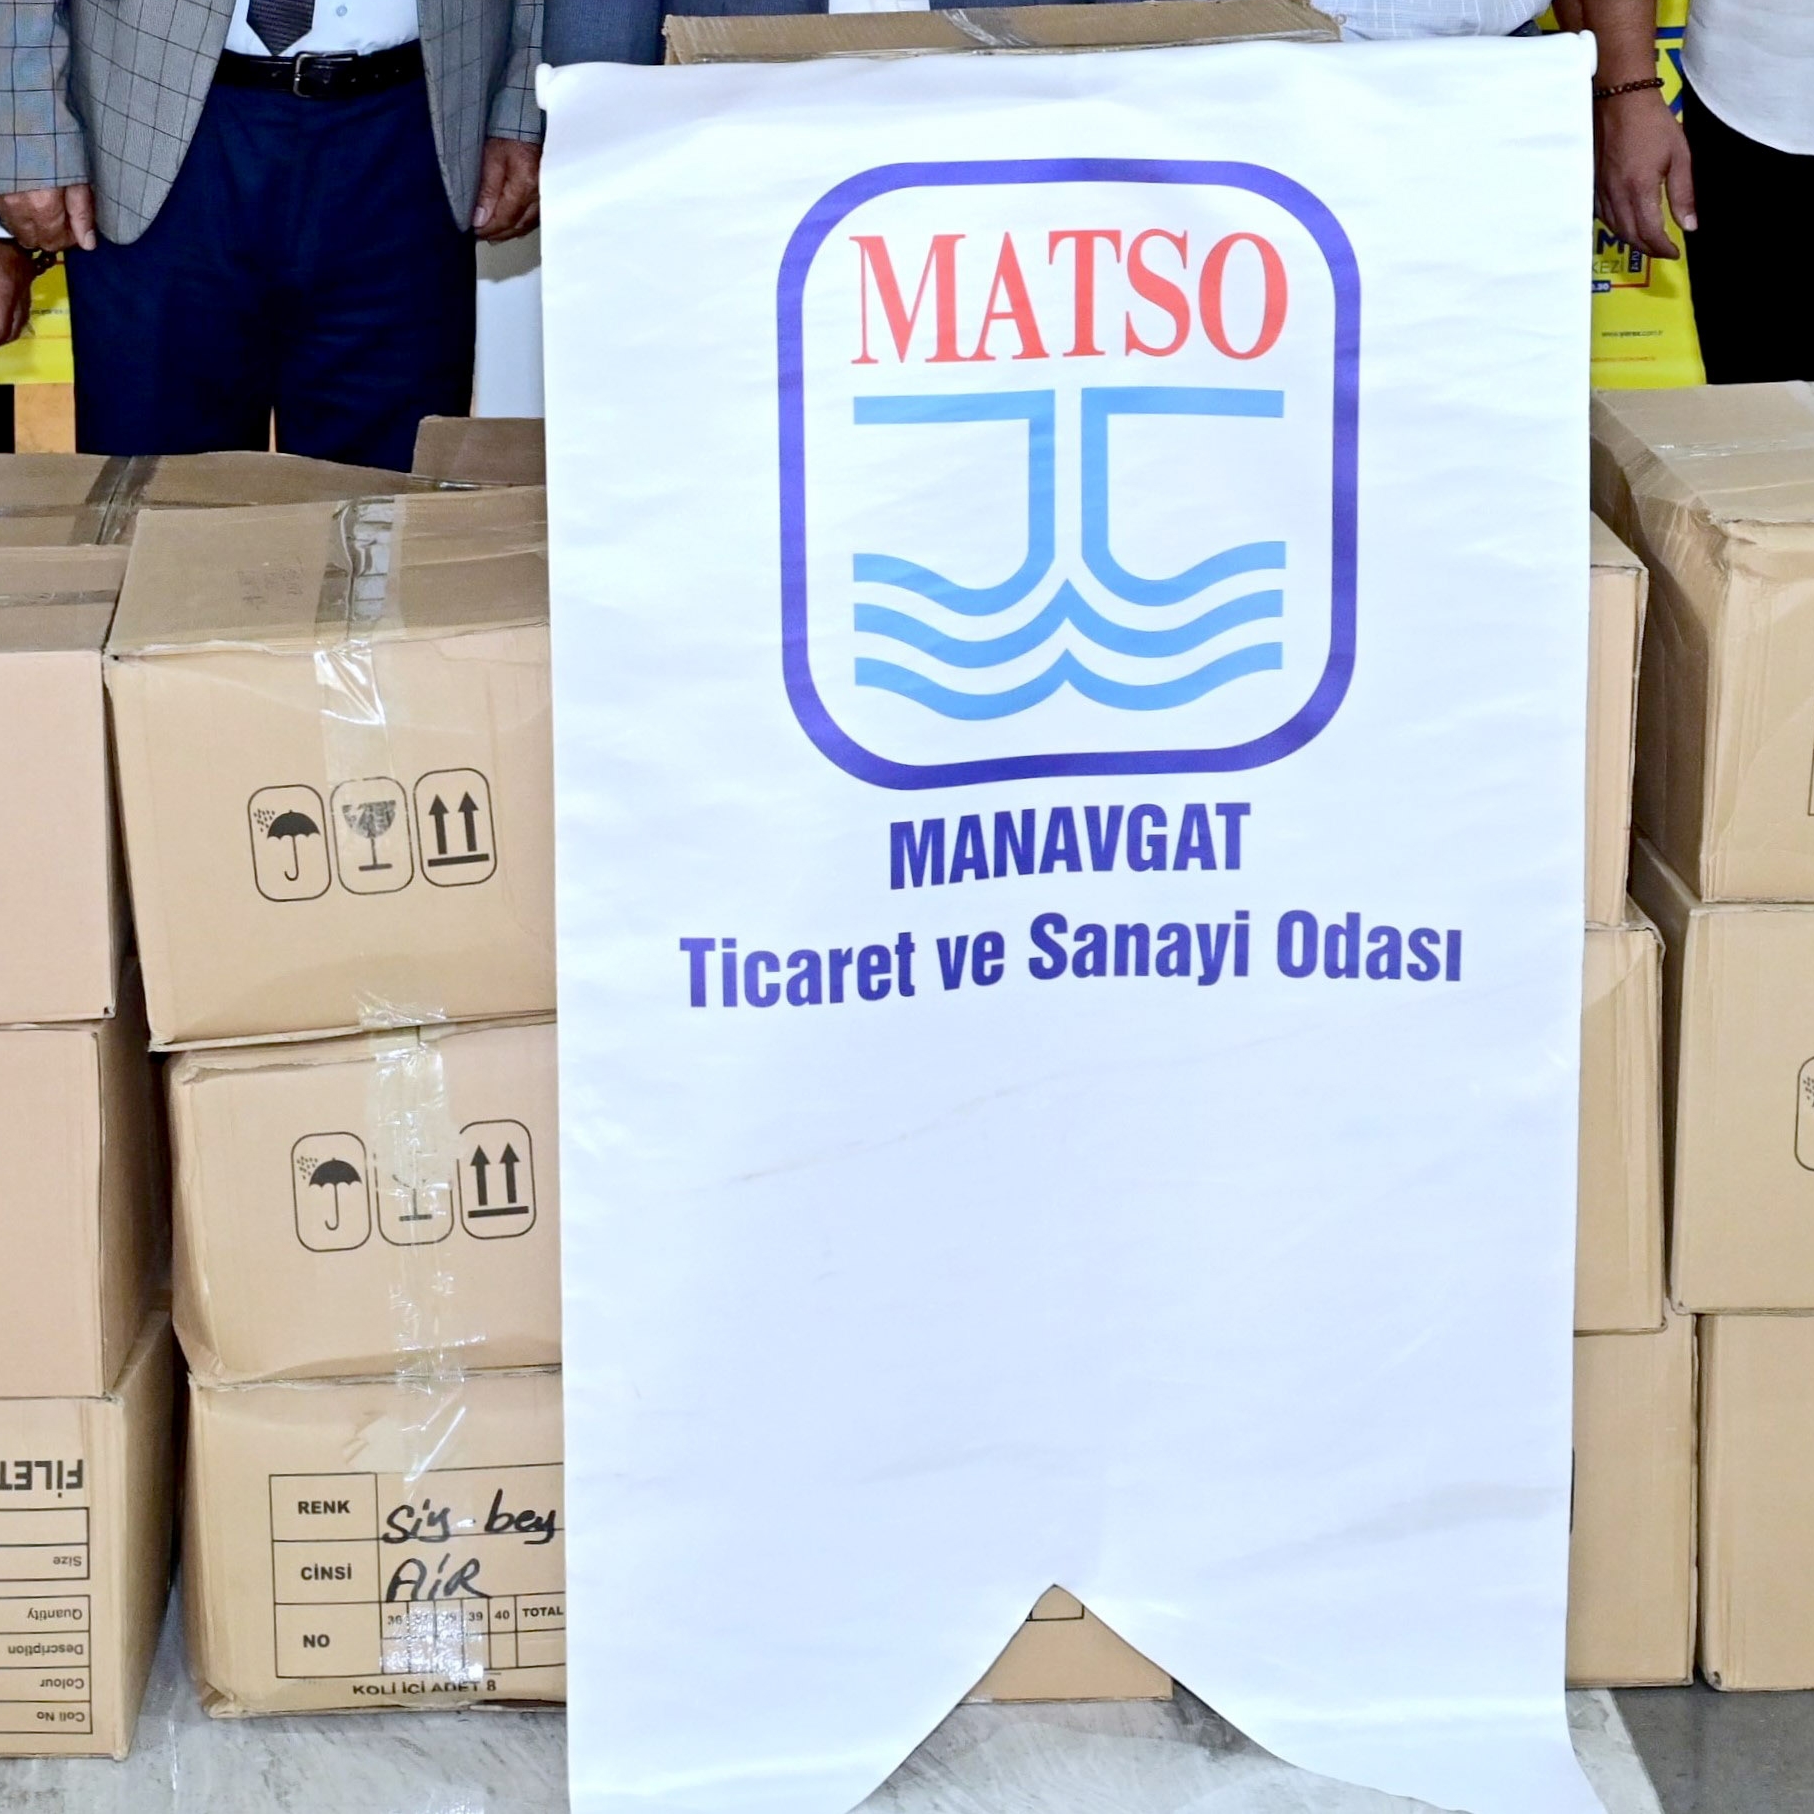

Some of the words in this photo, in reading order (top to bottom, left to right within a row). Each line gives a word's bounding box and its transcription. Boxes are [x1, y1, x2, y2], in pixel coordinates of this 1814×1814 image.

[848, 228, 1289, 365] MATSO
[889, 802, 1251, 890] MANAVGAT
[679, 930, 917, 1009] Ticaret
[937, 930, 1005, 991] ve
[1027, 909, 1251, 987] Sanayi
[1276, 909, 1463, 983] Odası
[298, 1500, 350, 1514] RENK
[53, 1555, 83, 1567] Size
[300, 1562, 352, 1580] CİNSİ
[27, 1606, 83, 1622] Quantity
[468, 1611, 484, 1622] 39
[494, 1610, 510, 1620] 40
[522, 1606, 563, 1618] TOTAL
[303, 1634, 330, 1648] NO
[8, 1643, 84, 1658] Description
[40, 1676, 85, 1690] Colour
[487, 1679, 497, 1692] 8
[36, 1710, 55, 1723] No
